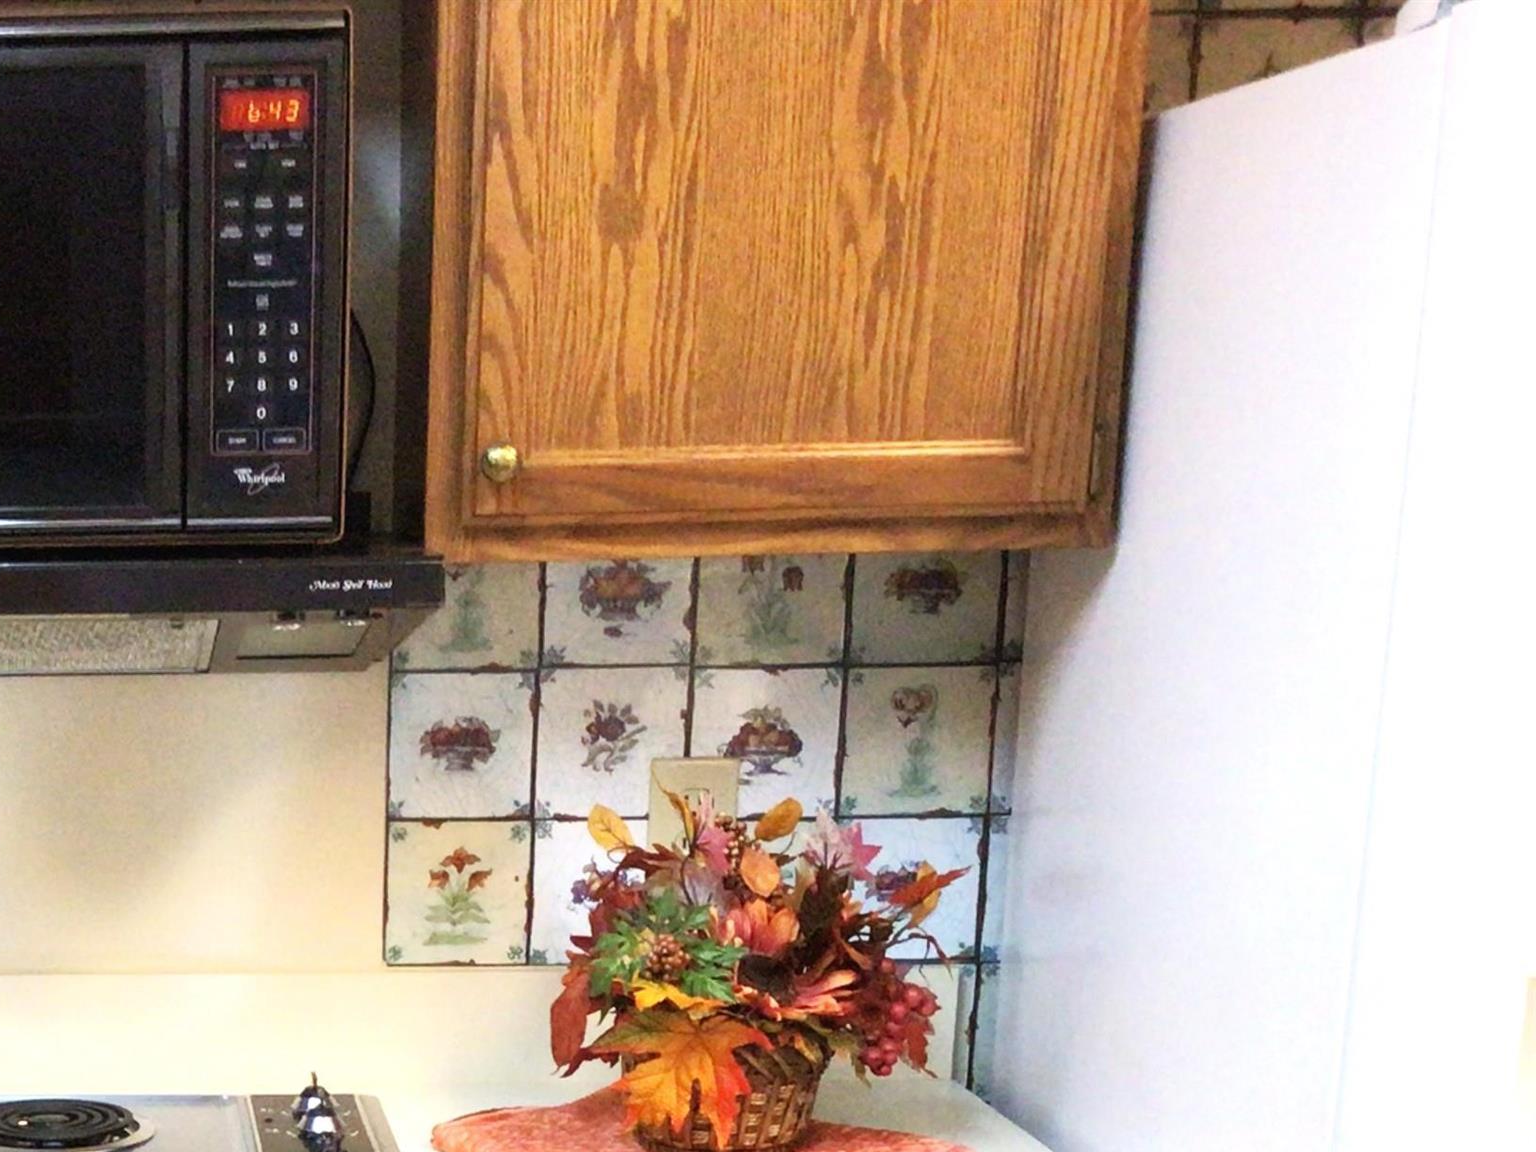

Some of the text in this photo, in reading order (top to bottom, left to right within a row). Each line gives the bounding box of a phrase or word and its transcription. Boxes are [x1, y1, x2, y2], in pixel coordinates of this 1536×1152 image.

[227, 321, 299, 337] 1 2 3
[225, 349, 299, 365] 4 5 6
[226, 377, 298, 392] 7 8 9
[256, 406, 267, 420] 0
[233, 465, 285, 491] Whirlpool
